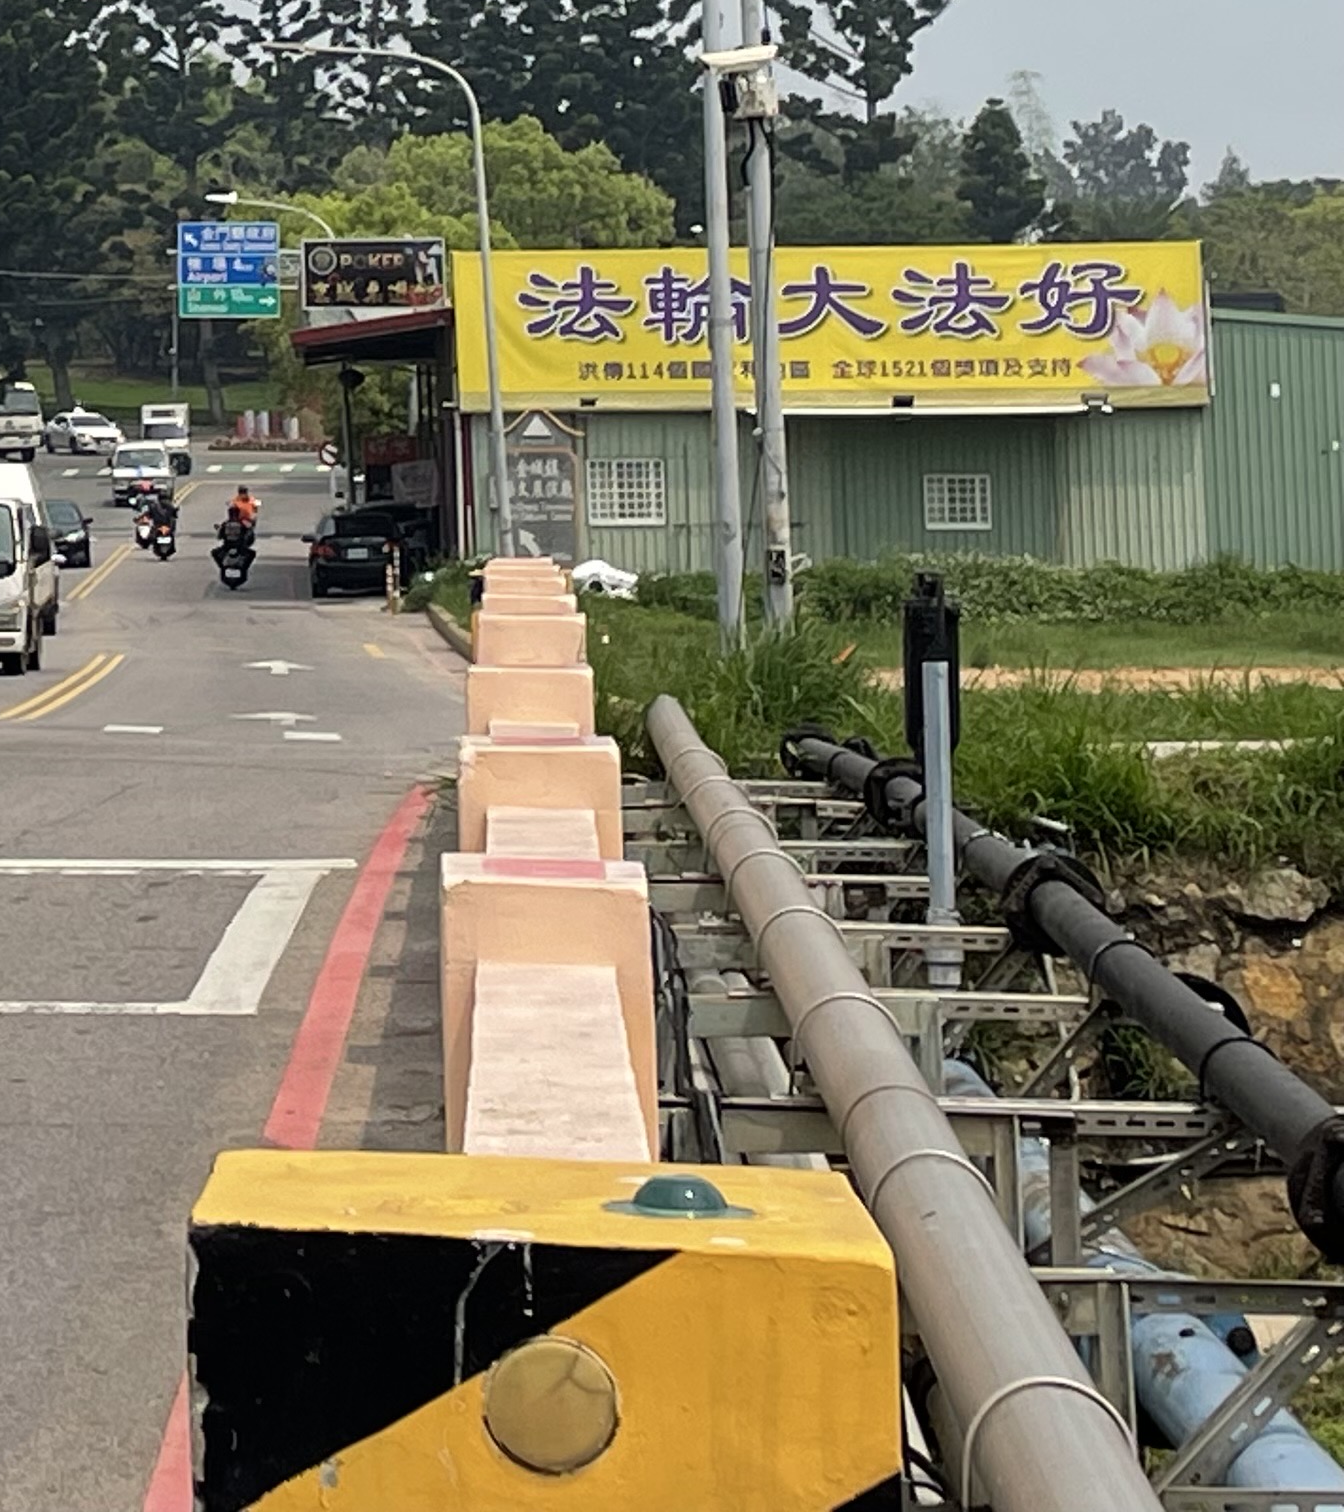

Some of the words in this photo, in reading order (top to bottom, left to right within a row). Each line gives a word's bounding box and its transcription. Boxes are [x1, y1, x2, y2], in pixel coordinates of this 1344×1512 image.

[517, 262, 1144, 342] 法輪大法好
